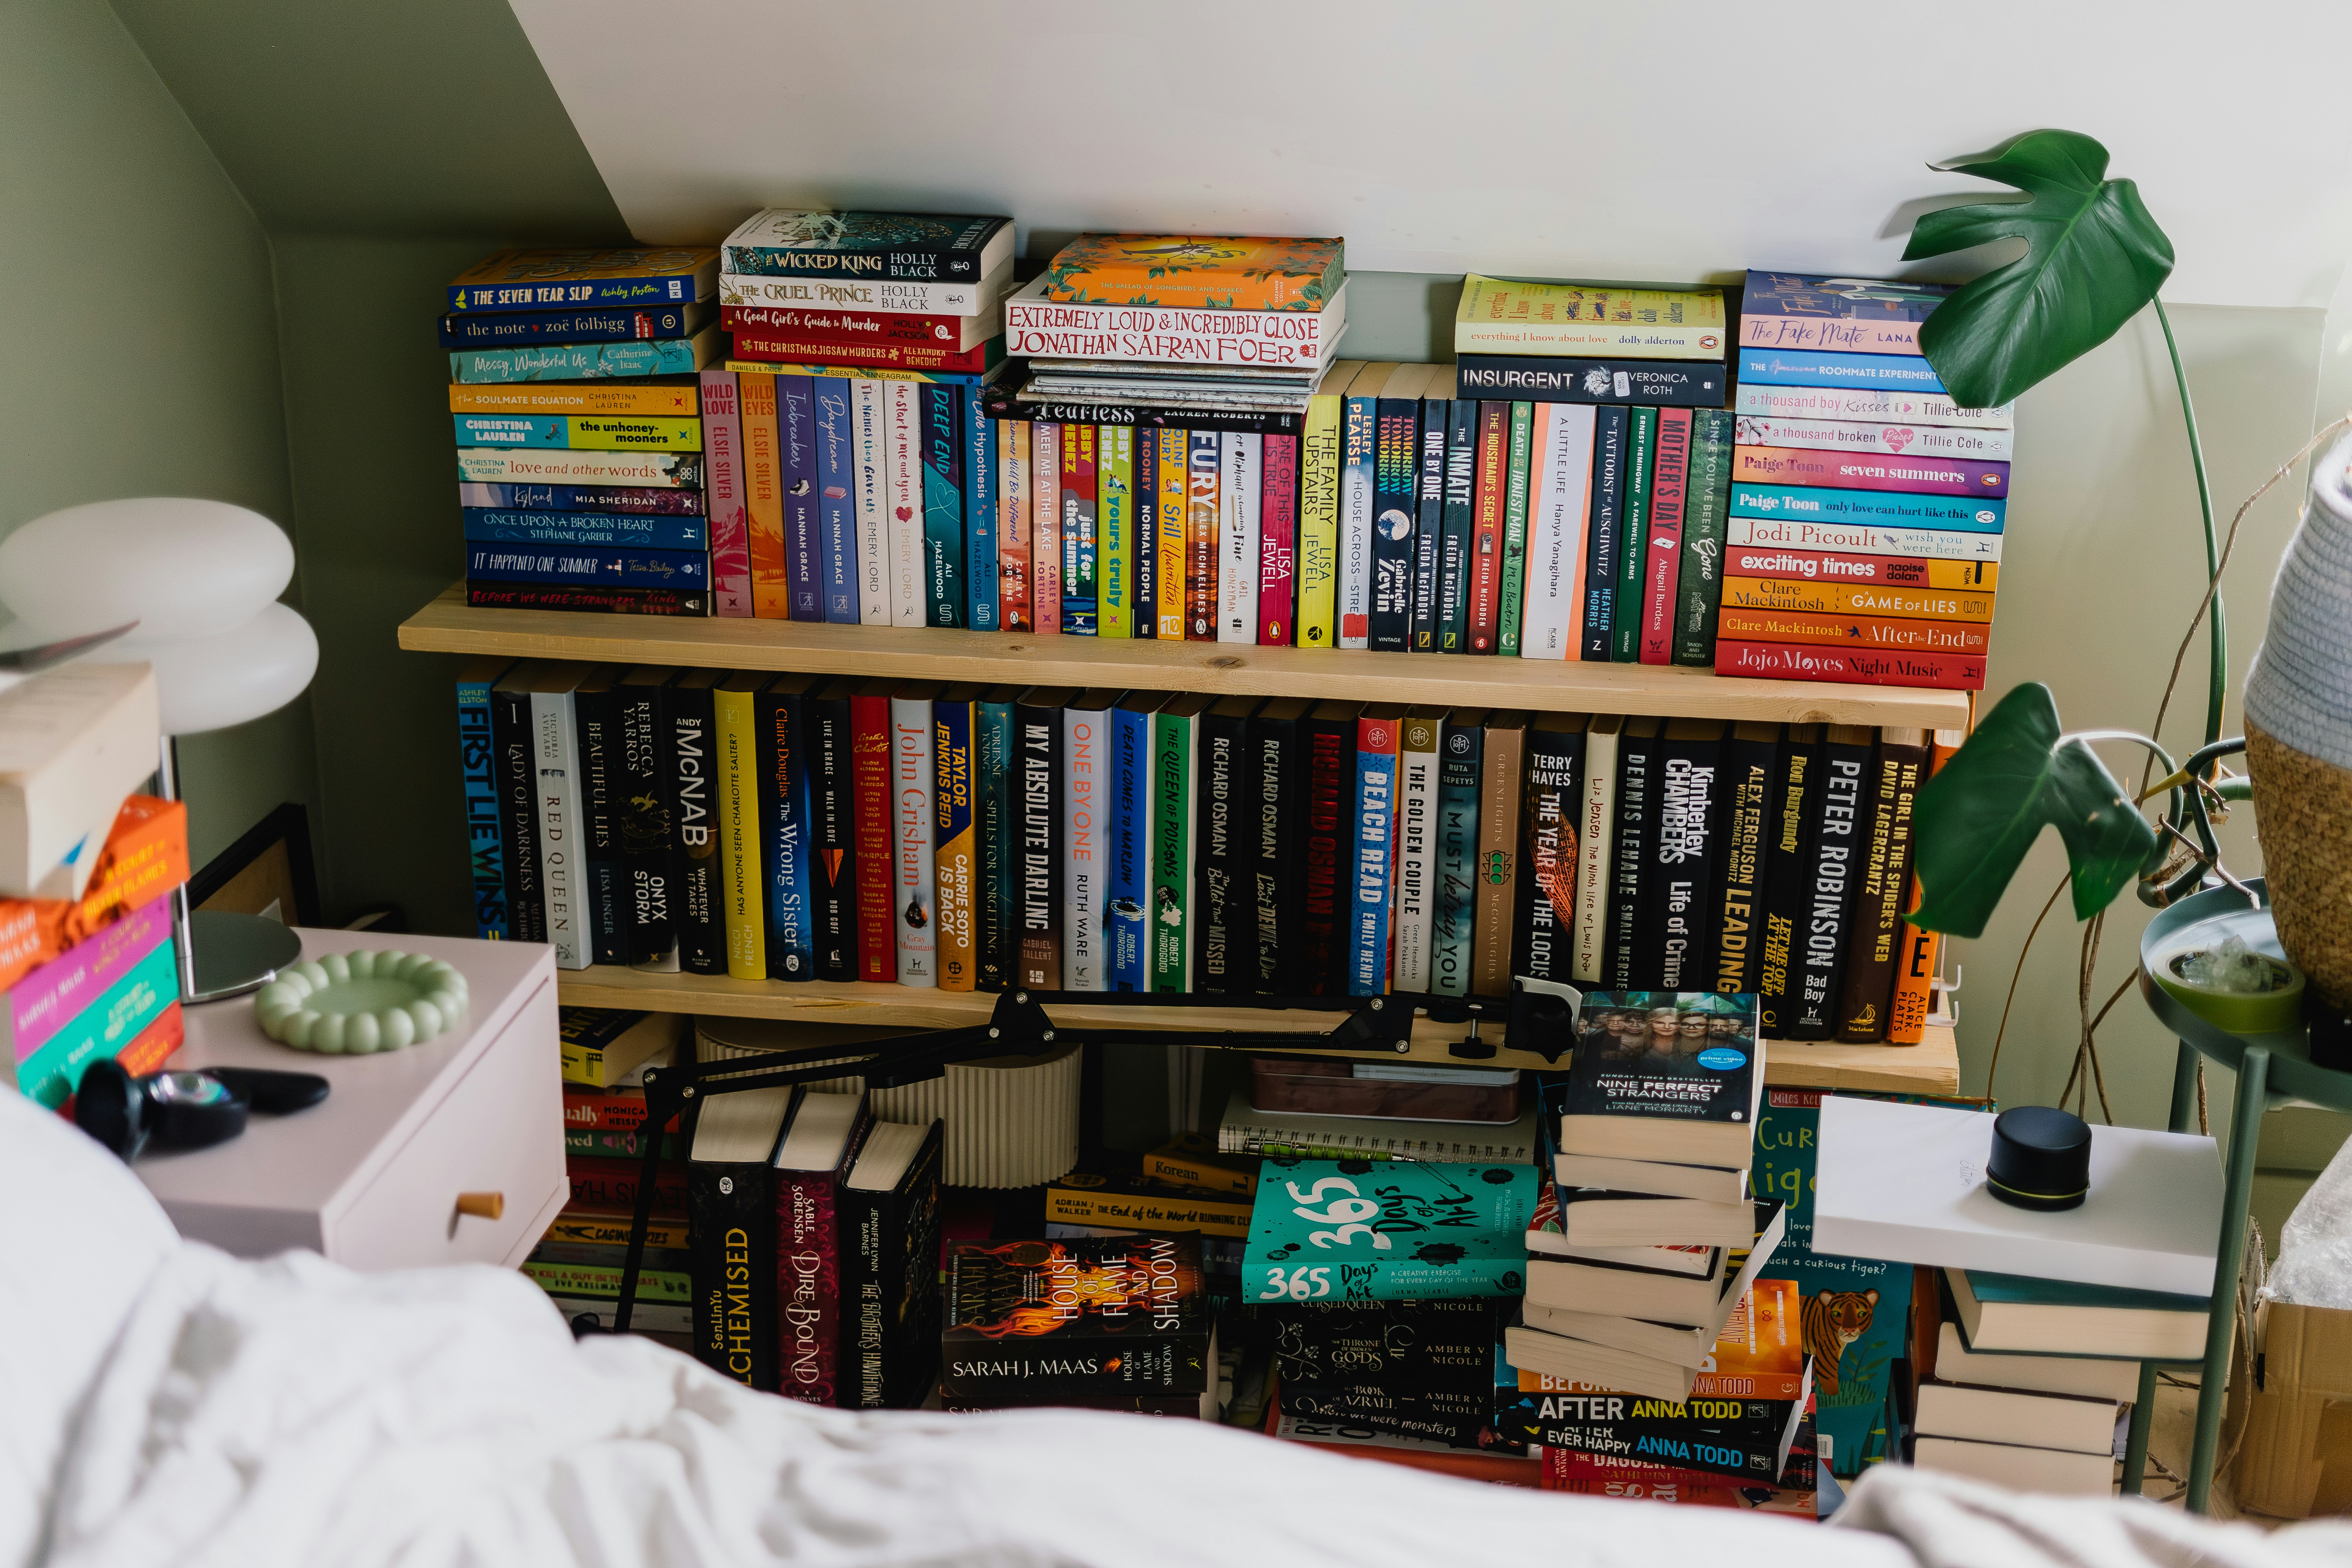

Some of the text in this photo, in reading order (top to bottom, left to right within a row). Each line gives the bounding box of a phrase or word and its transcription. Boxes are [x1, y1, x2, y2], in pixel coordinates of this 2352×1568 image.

[890, 253, 937, 265] HOLLY
[891, 266, 937, 277] BLACK
[474, 286, 593, 305] THE SEVEN YEAR SLIP
[881, 286, 929, 298] HOLLY
[882, 299, 929, 310] BLACK
[467, 318, 625, 336] the note zoë folbigg
[1008, 307, 1318, 339] EXTREMELY LOUD & INCREDIBLY CLOSE
[753, 341, 886, 358] THE CHRISTMAS JIGSAW MURDERS
[1010, 330, 1296, 363] JONATHAN SAFRAN FOER
[1471, 333, 1520, 343] everything
[1523, 333, 1527, 341] I
[1530, 333, 1555, 343] know
[1619, 336, 1642, 345] dolly
[1645, 336, 1684, 345] alderton
[1464, 369, 1573, 389] INSURGENT
[1629, 372, 1688, 383] VERONICA
[1643, 385, 1672, 394] ROTH
[476, 396, 583, 405] SOULMATE EQUATION
[466, 420, 533, 431] CHRISTINA
[475, 432, 525, 442] LAUREN
[580, 420, 659, 435] the unhoney-
[615, 434, 668, 444] mooners
[1348, 404, 1362, 466] PEARSE
[1362, 416, 1372, 454] LESLEY
[1557, 430, 1568, 466] LITTLE
[1923, 435, 1982, 449] Tillie Cole
[510, 461, 656, 478] love and other words
[713, 427, 731, 499] ELSIE SILVER
[1304, 436, 1319, 515] UPSTAIRS
[1319, 425, 1336, 525] THE FAMILY
[1655, 419, 1686, 531] MOTHER'S DAY
[1840, 465, 1964, 482] seven summers
[1040, 425, 1051, 550] MEET ME AT THE LAKE
[1556, 471, 1566, 493] LIFE
[599, 496, 656, 505] SHERIDAN
[1740, 494, 1779, 510] Paige
[1782, 496, 1819, 510] Toon
[1826, 503, 1849, 514] only
[1852, 503, 1873, 514] love
[1898, 506, 1921, 516] hurt
[1925, 507, 1944, 517] like
[1947, 508, 1968, 519] this
[1552, 504, 1564, 537] Hanya
[1744, 521, 1877, 547] Jodi Picoult
[798, 508, 808, 582] HANNAH GRACE
[868, 522, 879, 592] EMERY LORD
[1107, 496, 1122, 608] yours truly
[1198, 542, 1206, 613] MICHAELIDES
[1443, 535, 1457, 621] FREIDA McFADDEN
[1549, 540, 1561, 597] Yanagihara
[1741, 555, 1875, 576] exciting times
[1886, 572, 1919, 581] dolan
[1887, 564, 1925, 572] naoise
[1654, 558, 1668, 630] Abigail Burdess
[937, 721, 951, 828] JENKINS REID
[1533, 754, 1572, 770] TERRY
[677, 729, 707, 846] McNAB
[953, 747, 966, 807] TAYLOR
[1532, 771, 1570, 786] HAYES
[1074, 724, 1091, 862] ONE BY ONE
[729, 733, 745, 915] HAS ANYONE SEEN CHARLOTTE SALTER?
[1025, 724, 1048, 929] MY ABSOLUTE DARLING
[1359, 771, 1387, 902] BEACH READ
[1404, 765, 1425, 915] THE GOLDEN COUPLE
[547, 796, 568, 931] RED QUEEN
[1806, 760, 1861, 967] PETER ROBINSON
[1076, 875, 1087, 957] RUTH WARE
[1359, 913, 1376, 985] EMILY HENRY
[1804, 988, 1825, 1003] Boy
[1806, 975, 1827, 988] Bad
[1597, 1080, 1722, 1093] NINE PERFECT
[1607, 1089, 1710, 1101] STRANGERS
[1053, 1253, 1078, 1319] HOUSE
[1102, 1253, 1128, 1316] FLAME
[1150, 1238, 1180, 1329] SHADOW
[1259, 1266, 1330, 1300] 365
[953, 1359, 1097, 1378] SARAH J. MAAS
[1539, 1396, 1742, 1420] AFTER ANNA TODD
